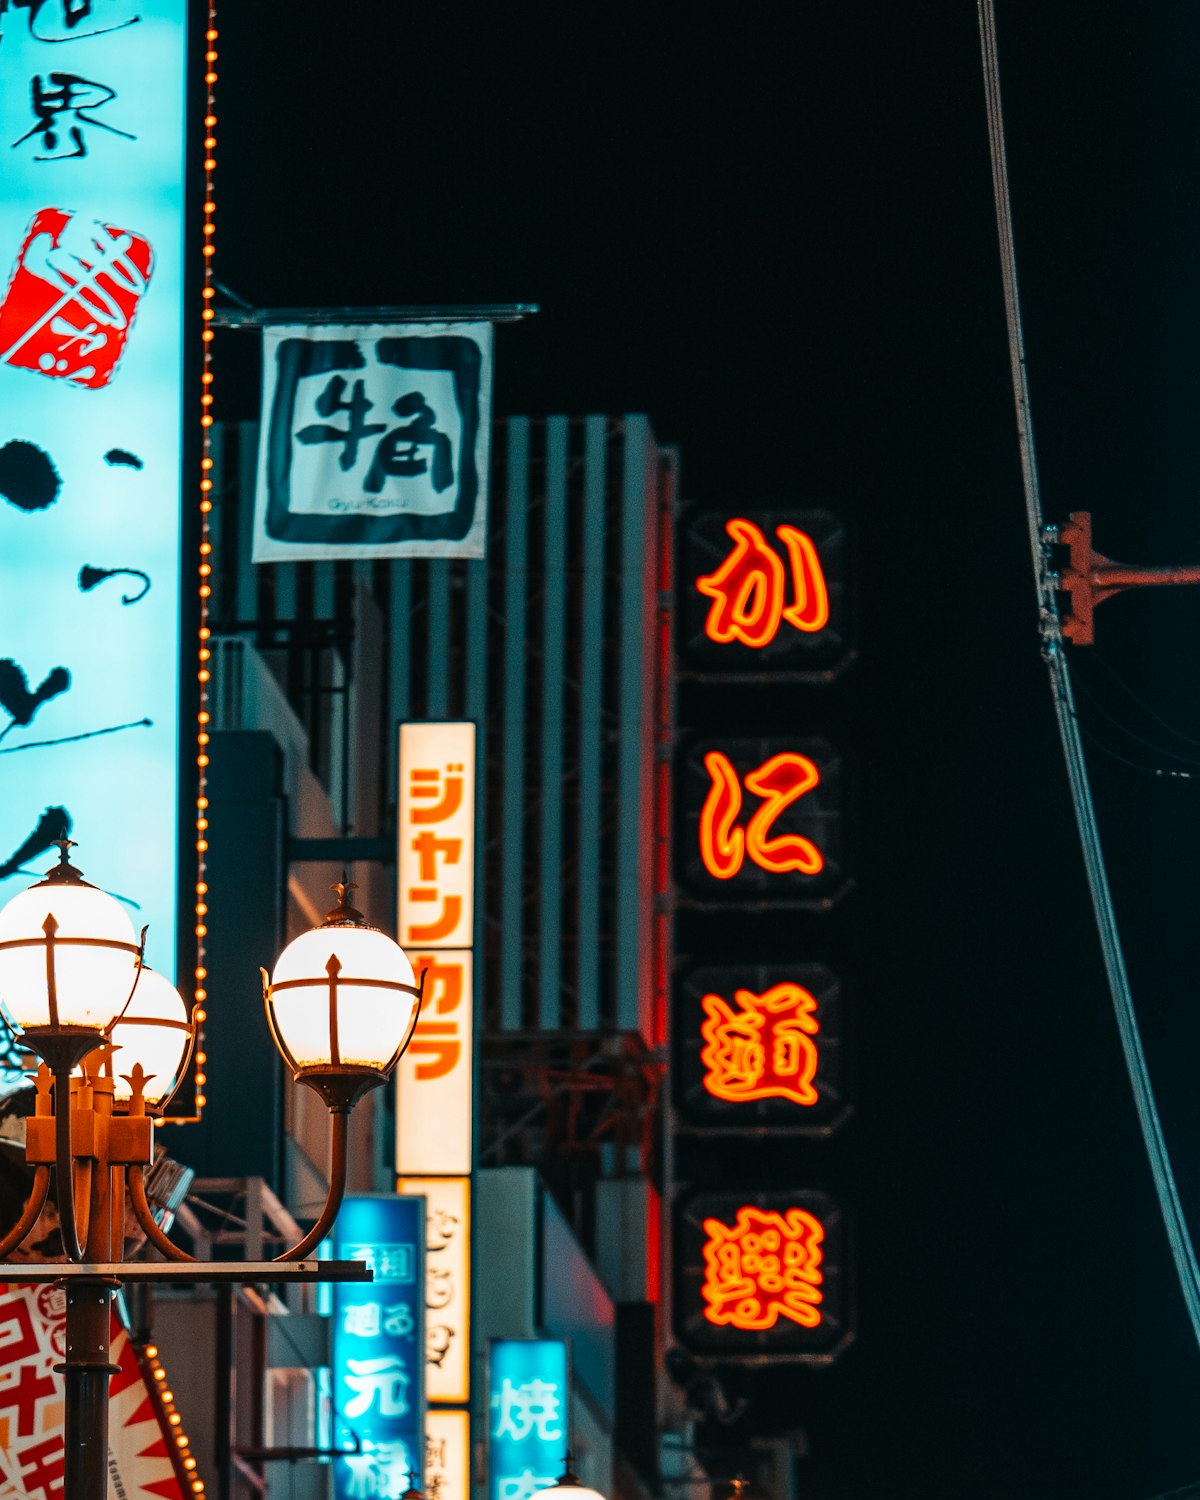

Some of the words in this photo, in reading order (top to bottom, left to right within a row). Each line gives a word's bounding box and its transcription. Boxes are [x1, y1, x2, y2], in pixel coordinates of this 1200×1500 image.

[295, 373, 457, 494] 牛角
[407, 763, 464, 1081] ジャンカラ
[696, 517, 829, 1331] かに道楽
